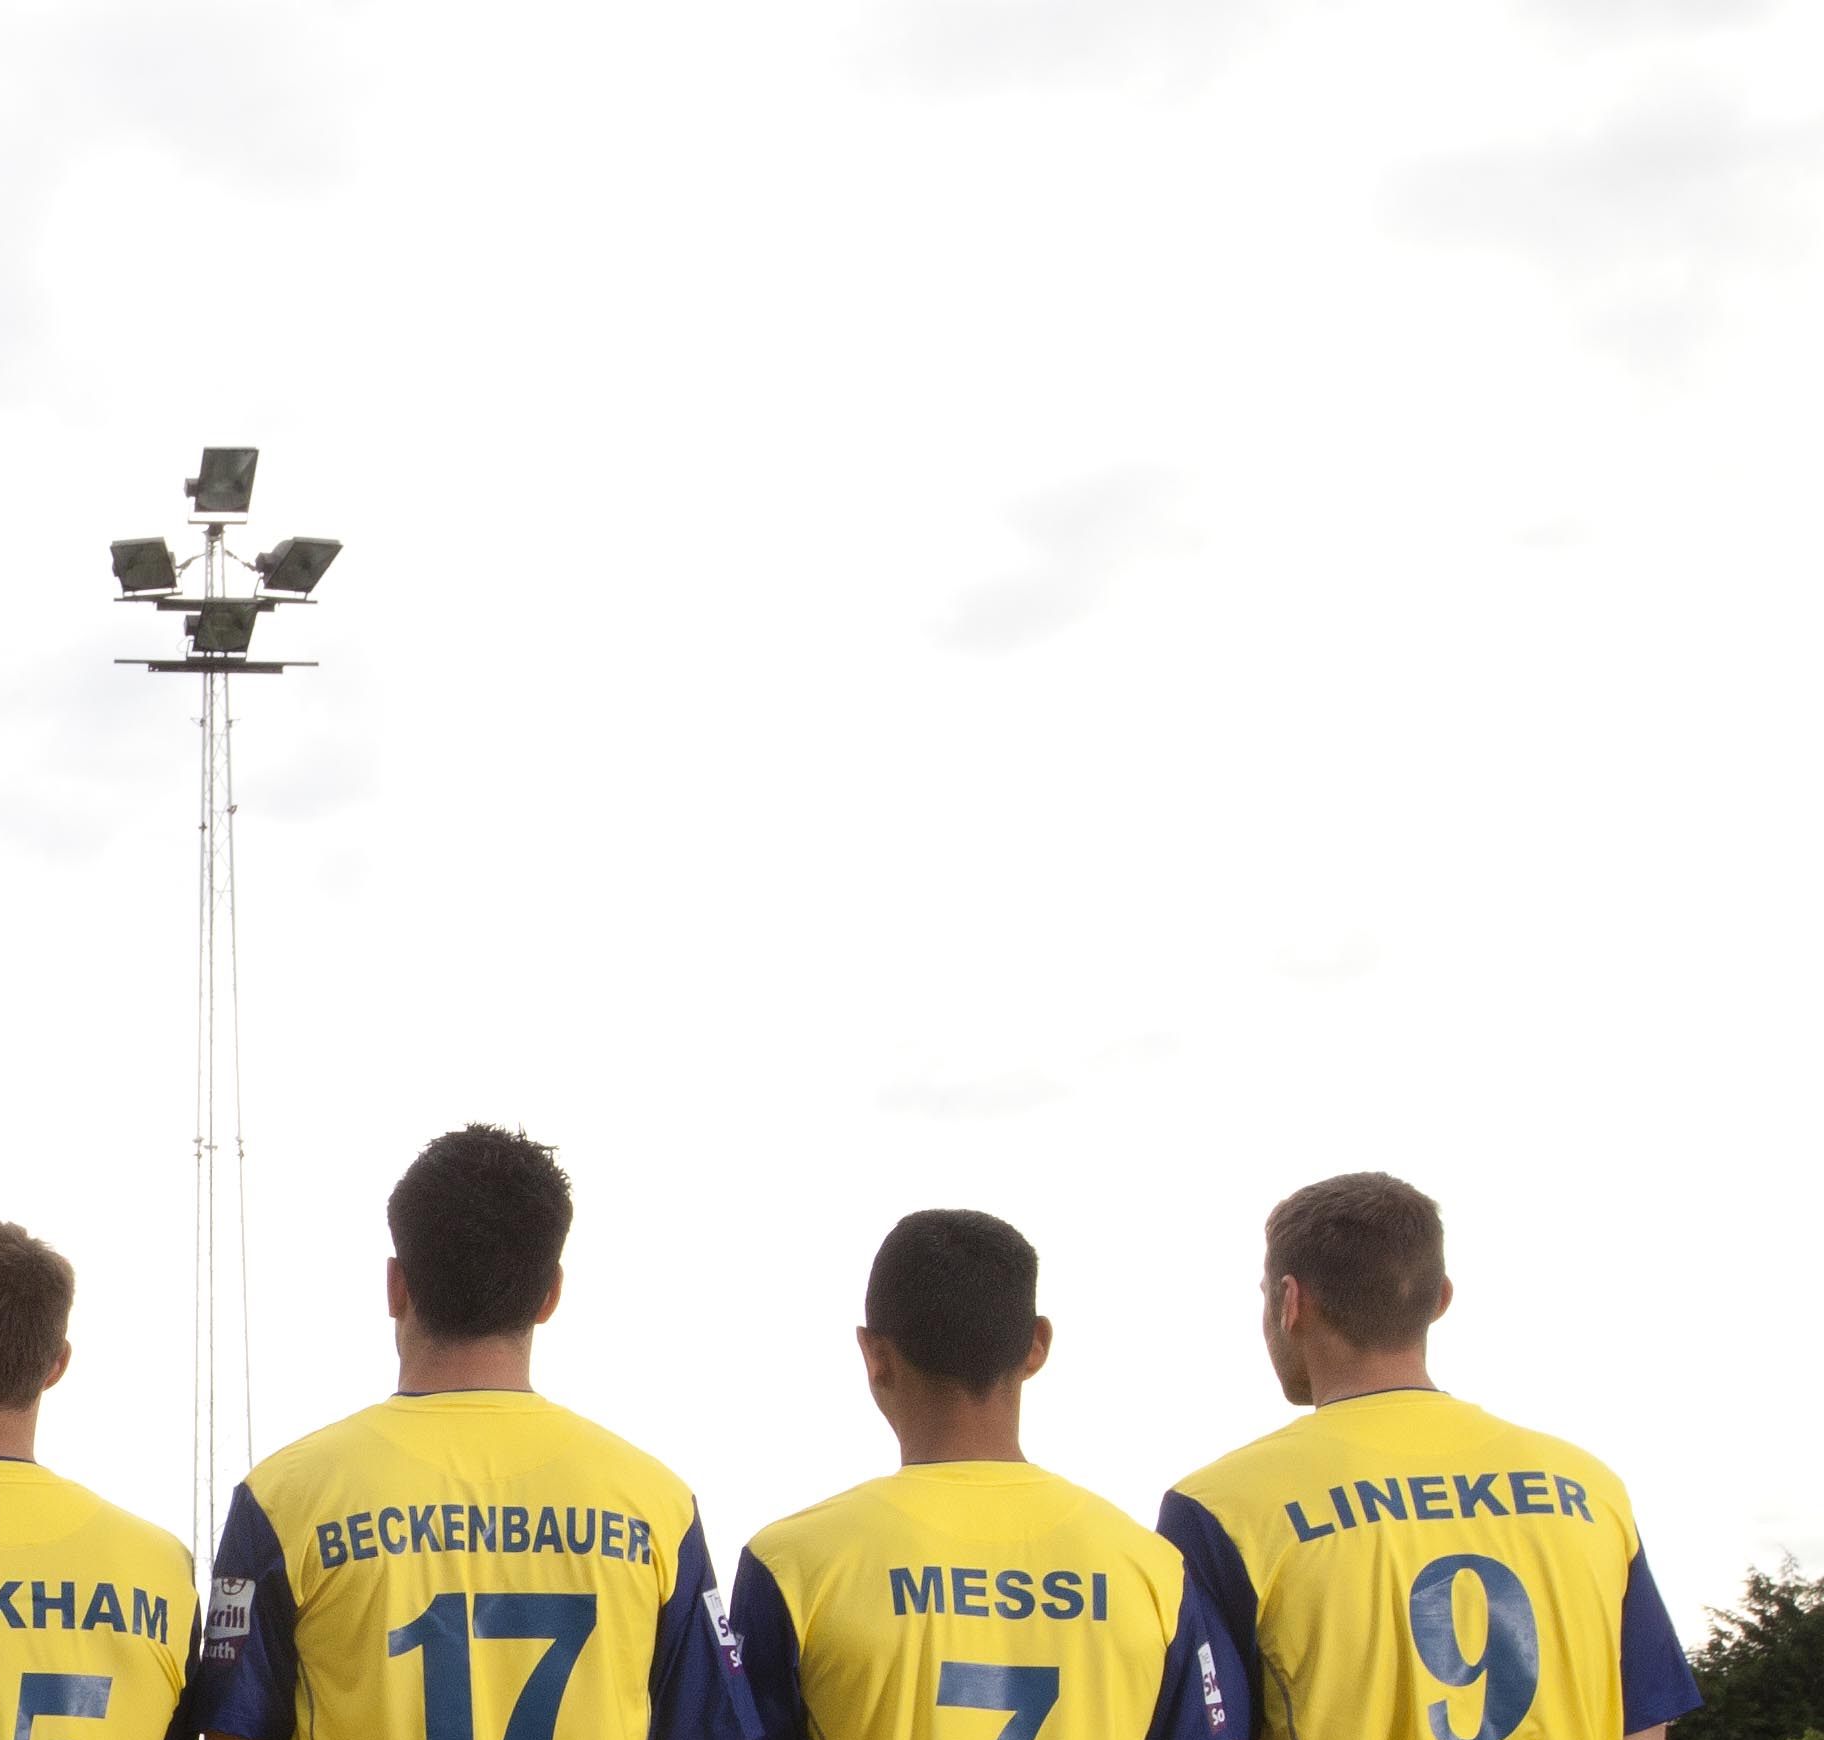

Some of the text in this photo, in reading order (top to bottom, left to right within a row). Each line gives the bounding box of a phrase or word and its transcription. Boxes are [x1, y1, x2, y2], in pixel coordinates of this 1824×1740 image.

[318, 1505, 650, 1568] BECKENBAUER
[1287, 1472, 1591, 1541] LINEKER
[890, 1567, 1106, 1620] MESSI
